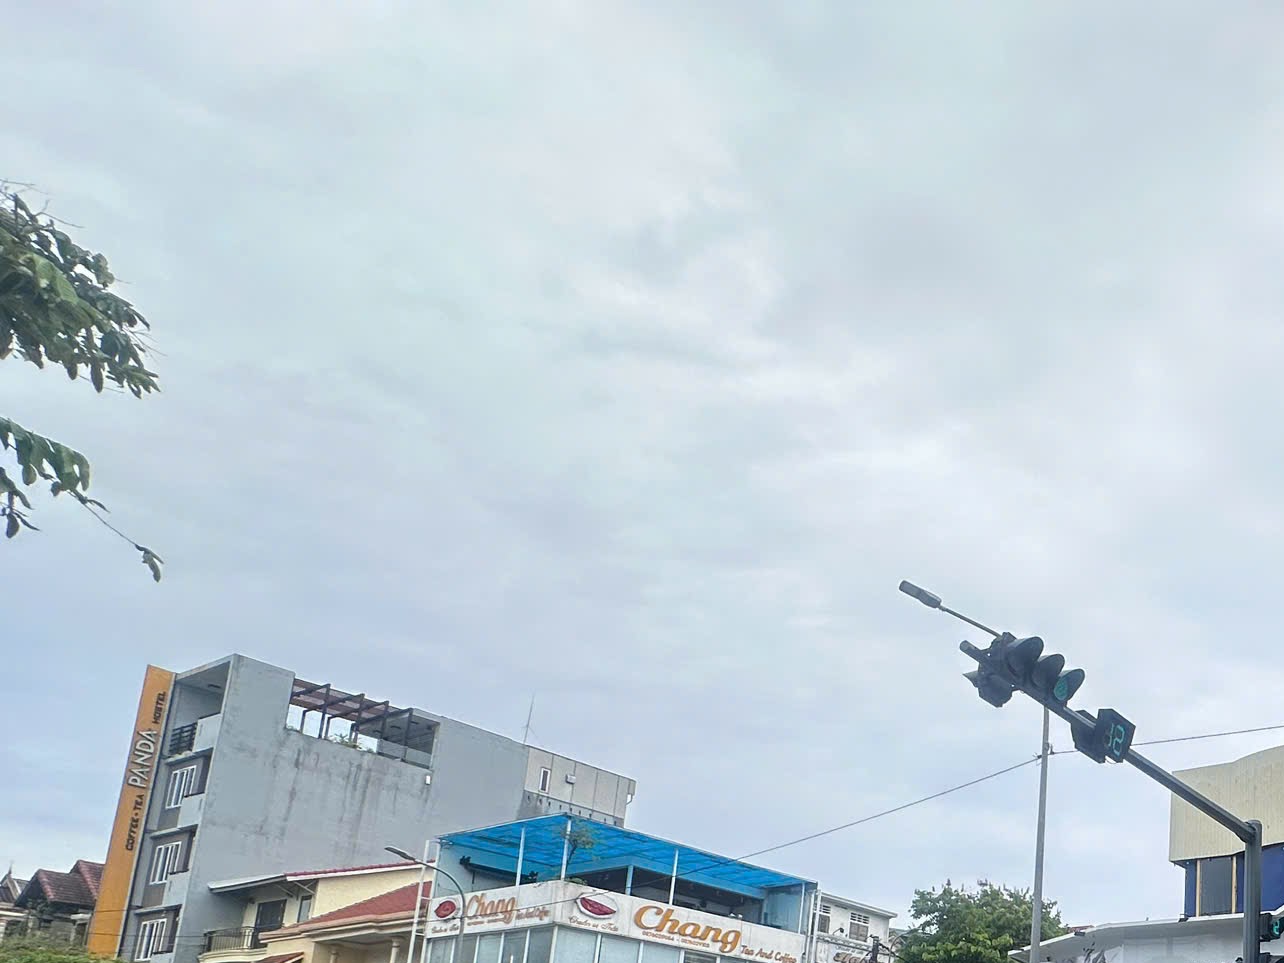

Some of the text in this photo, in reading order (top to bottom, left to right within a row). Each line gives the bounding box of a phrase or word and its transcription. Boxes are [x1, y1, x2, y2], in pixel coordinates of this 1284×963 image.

[128, 728, 157, 788] PANDA
[152, 691, 167, 725] HOSTEL
[633, 904, 742, 953] Chang
